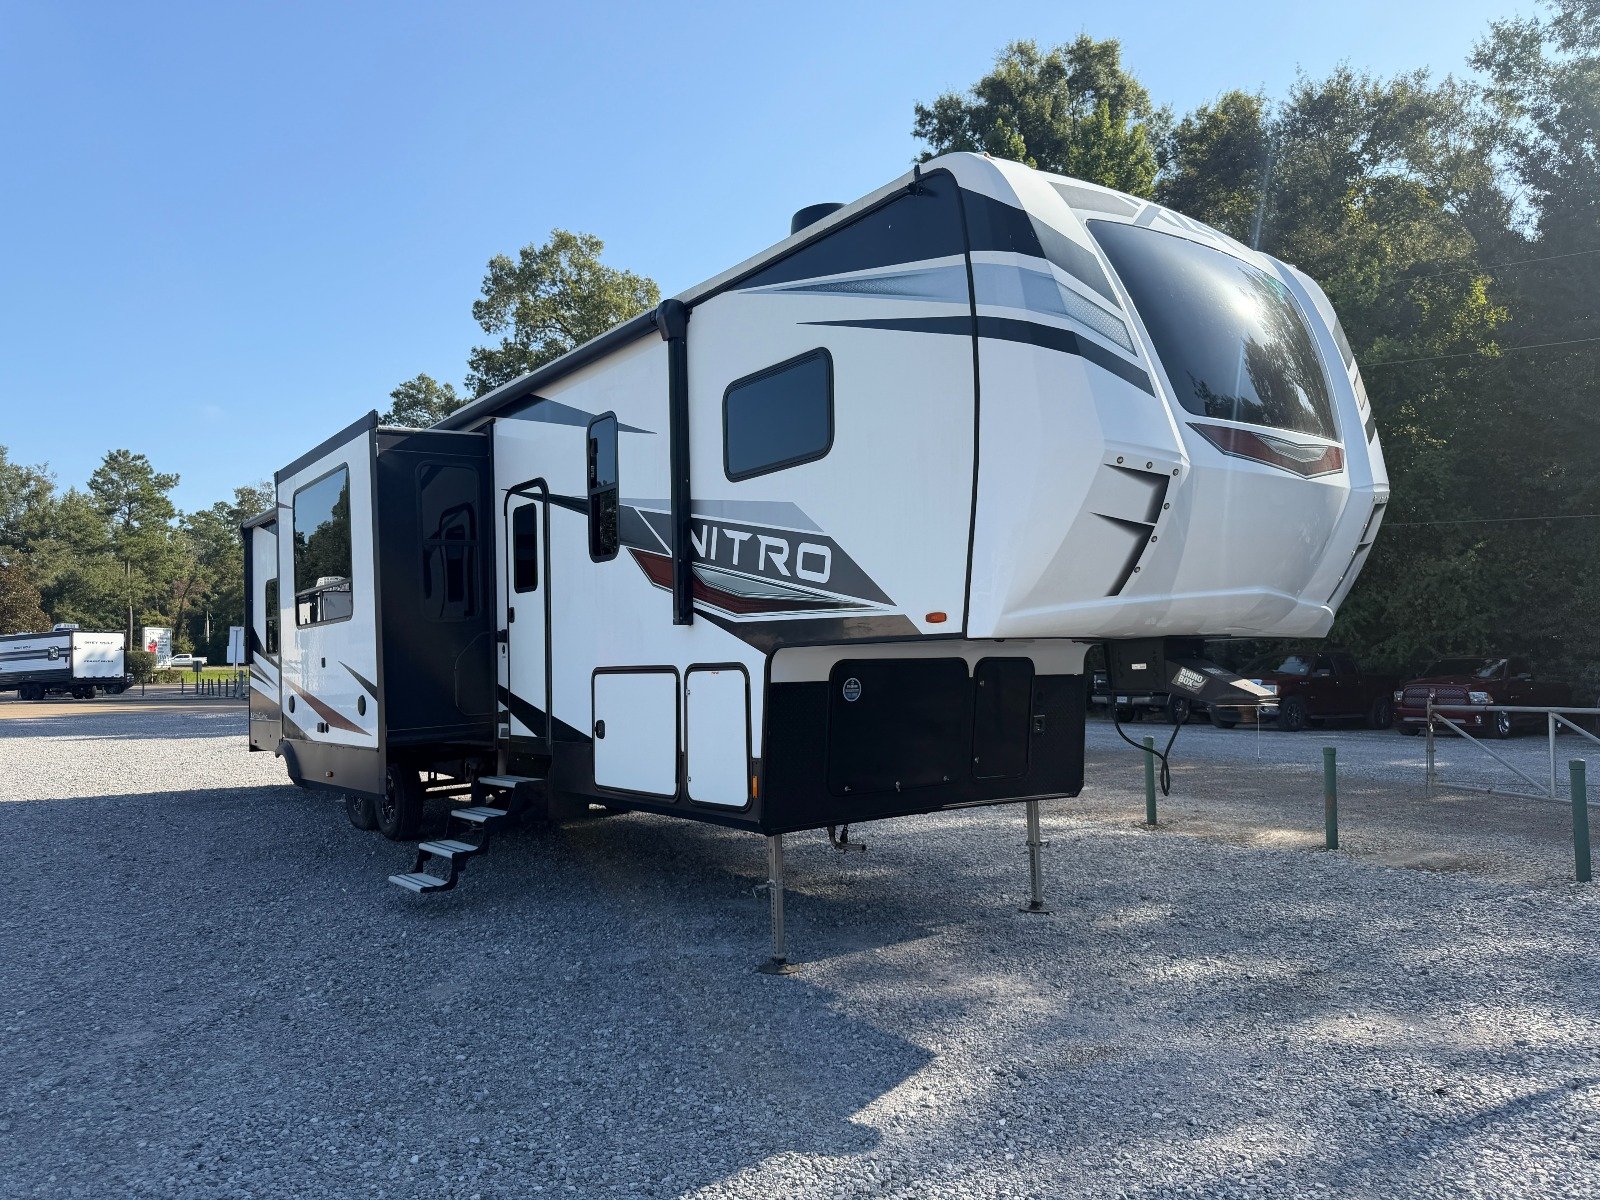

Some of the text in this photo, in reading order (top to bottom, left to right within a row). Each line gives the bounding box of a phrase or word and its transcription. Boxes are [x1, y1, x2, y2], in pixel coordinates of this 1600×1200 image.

[691, 525, 832, 584] NITRO
[1178, 675, 1194, 687] BOX
[1181, 668, 1203, 683] RHINO
